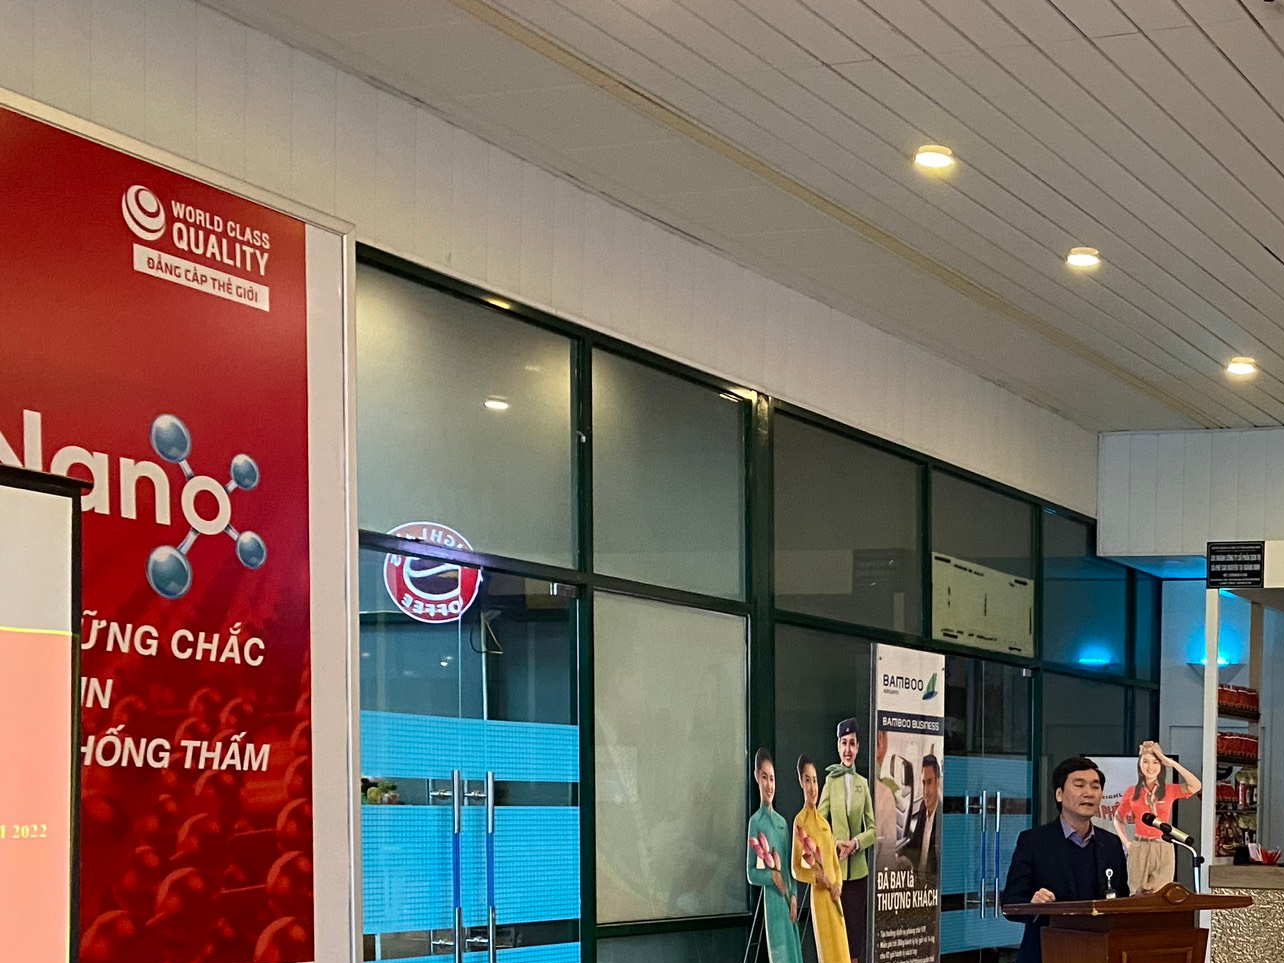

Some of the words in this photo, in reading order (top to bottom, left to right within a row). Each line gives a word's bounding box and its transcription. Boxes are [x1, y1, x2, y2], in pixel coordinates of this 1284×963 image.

[171, 200, 223, 232] WORLD
[226, 221, 270, 249] CLASS
[172, 222, 269, 276] QUALITY
[171, 622, 265, 667] CHẮC
[80, 724, 171, 769] HỐNG
[180, 731, 271, 772] THẤM
[12, 823, 48, 839] 2022
[890, 870, 906, 888] BAY
[906, 870, 914, 888] là
[912, 884, 938, 908] KHÁCH
